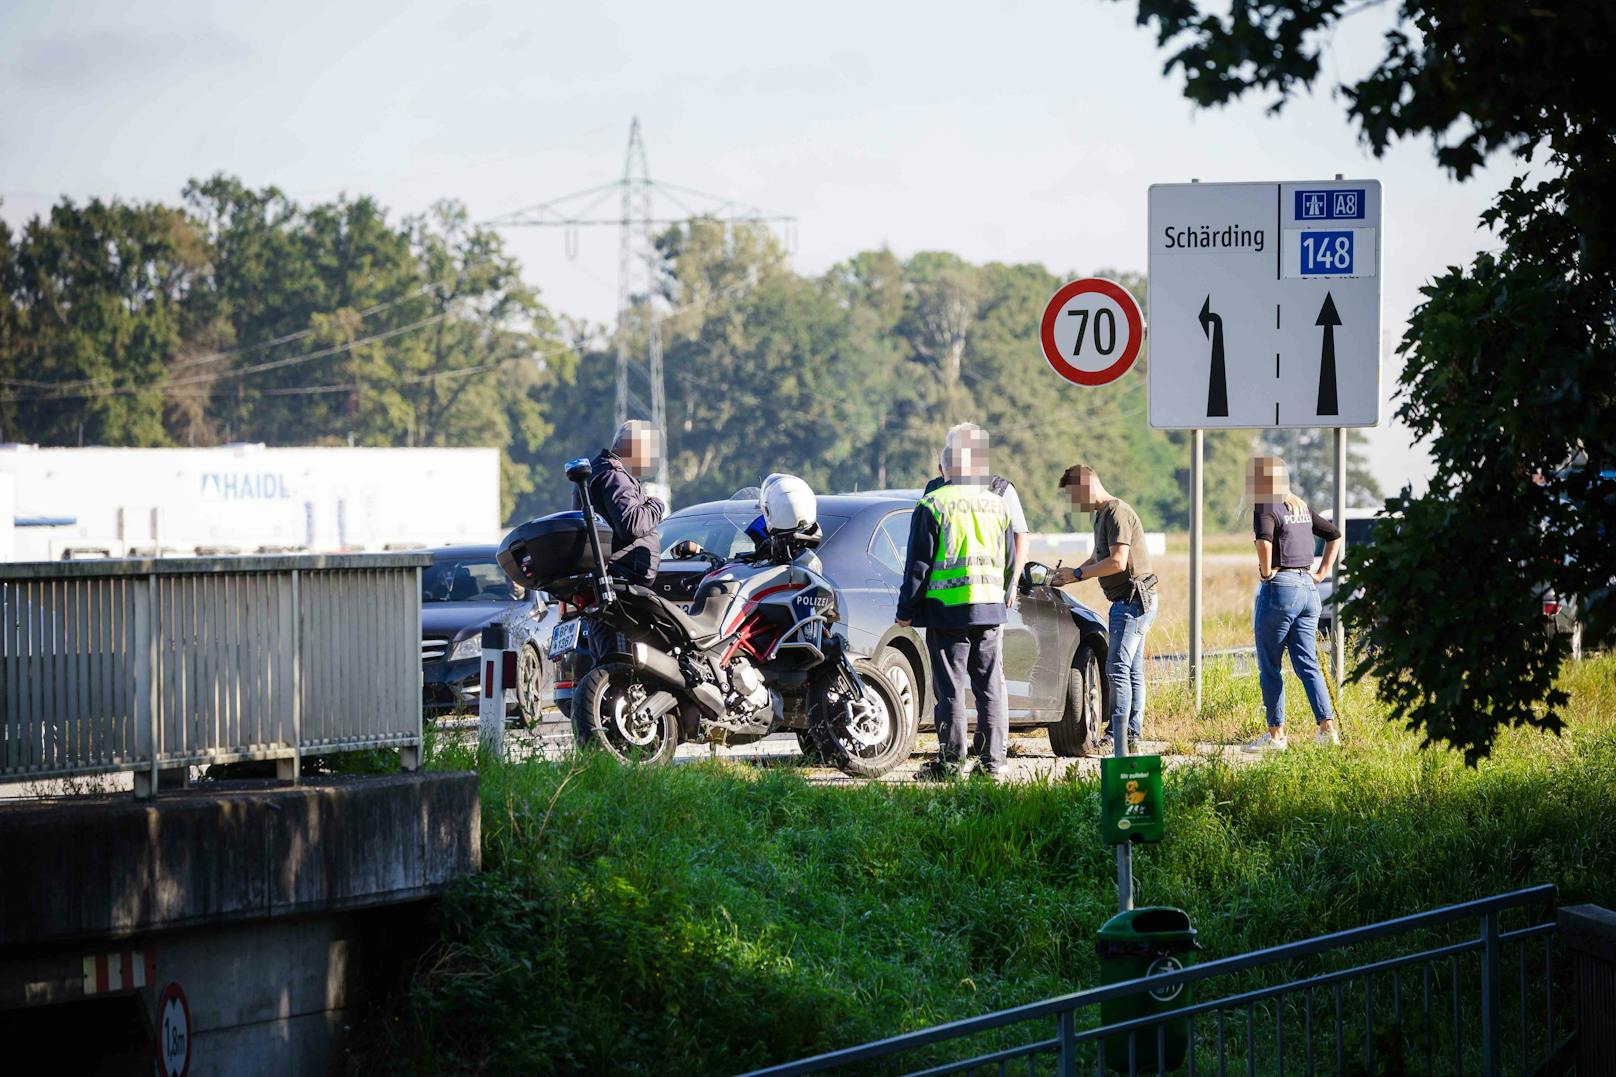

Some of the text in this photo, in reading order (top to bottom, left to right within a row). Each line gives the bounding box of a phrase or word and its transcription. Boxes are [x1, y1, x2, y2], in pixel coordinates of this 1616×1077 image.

[1335, 195, 1355, 215] A8
[1164, 224, 1264, 252] Schärding
[1302, 236, 1350, 269] 148
[1067, 307, 1116, 356] 70
